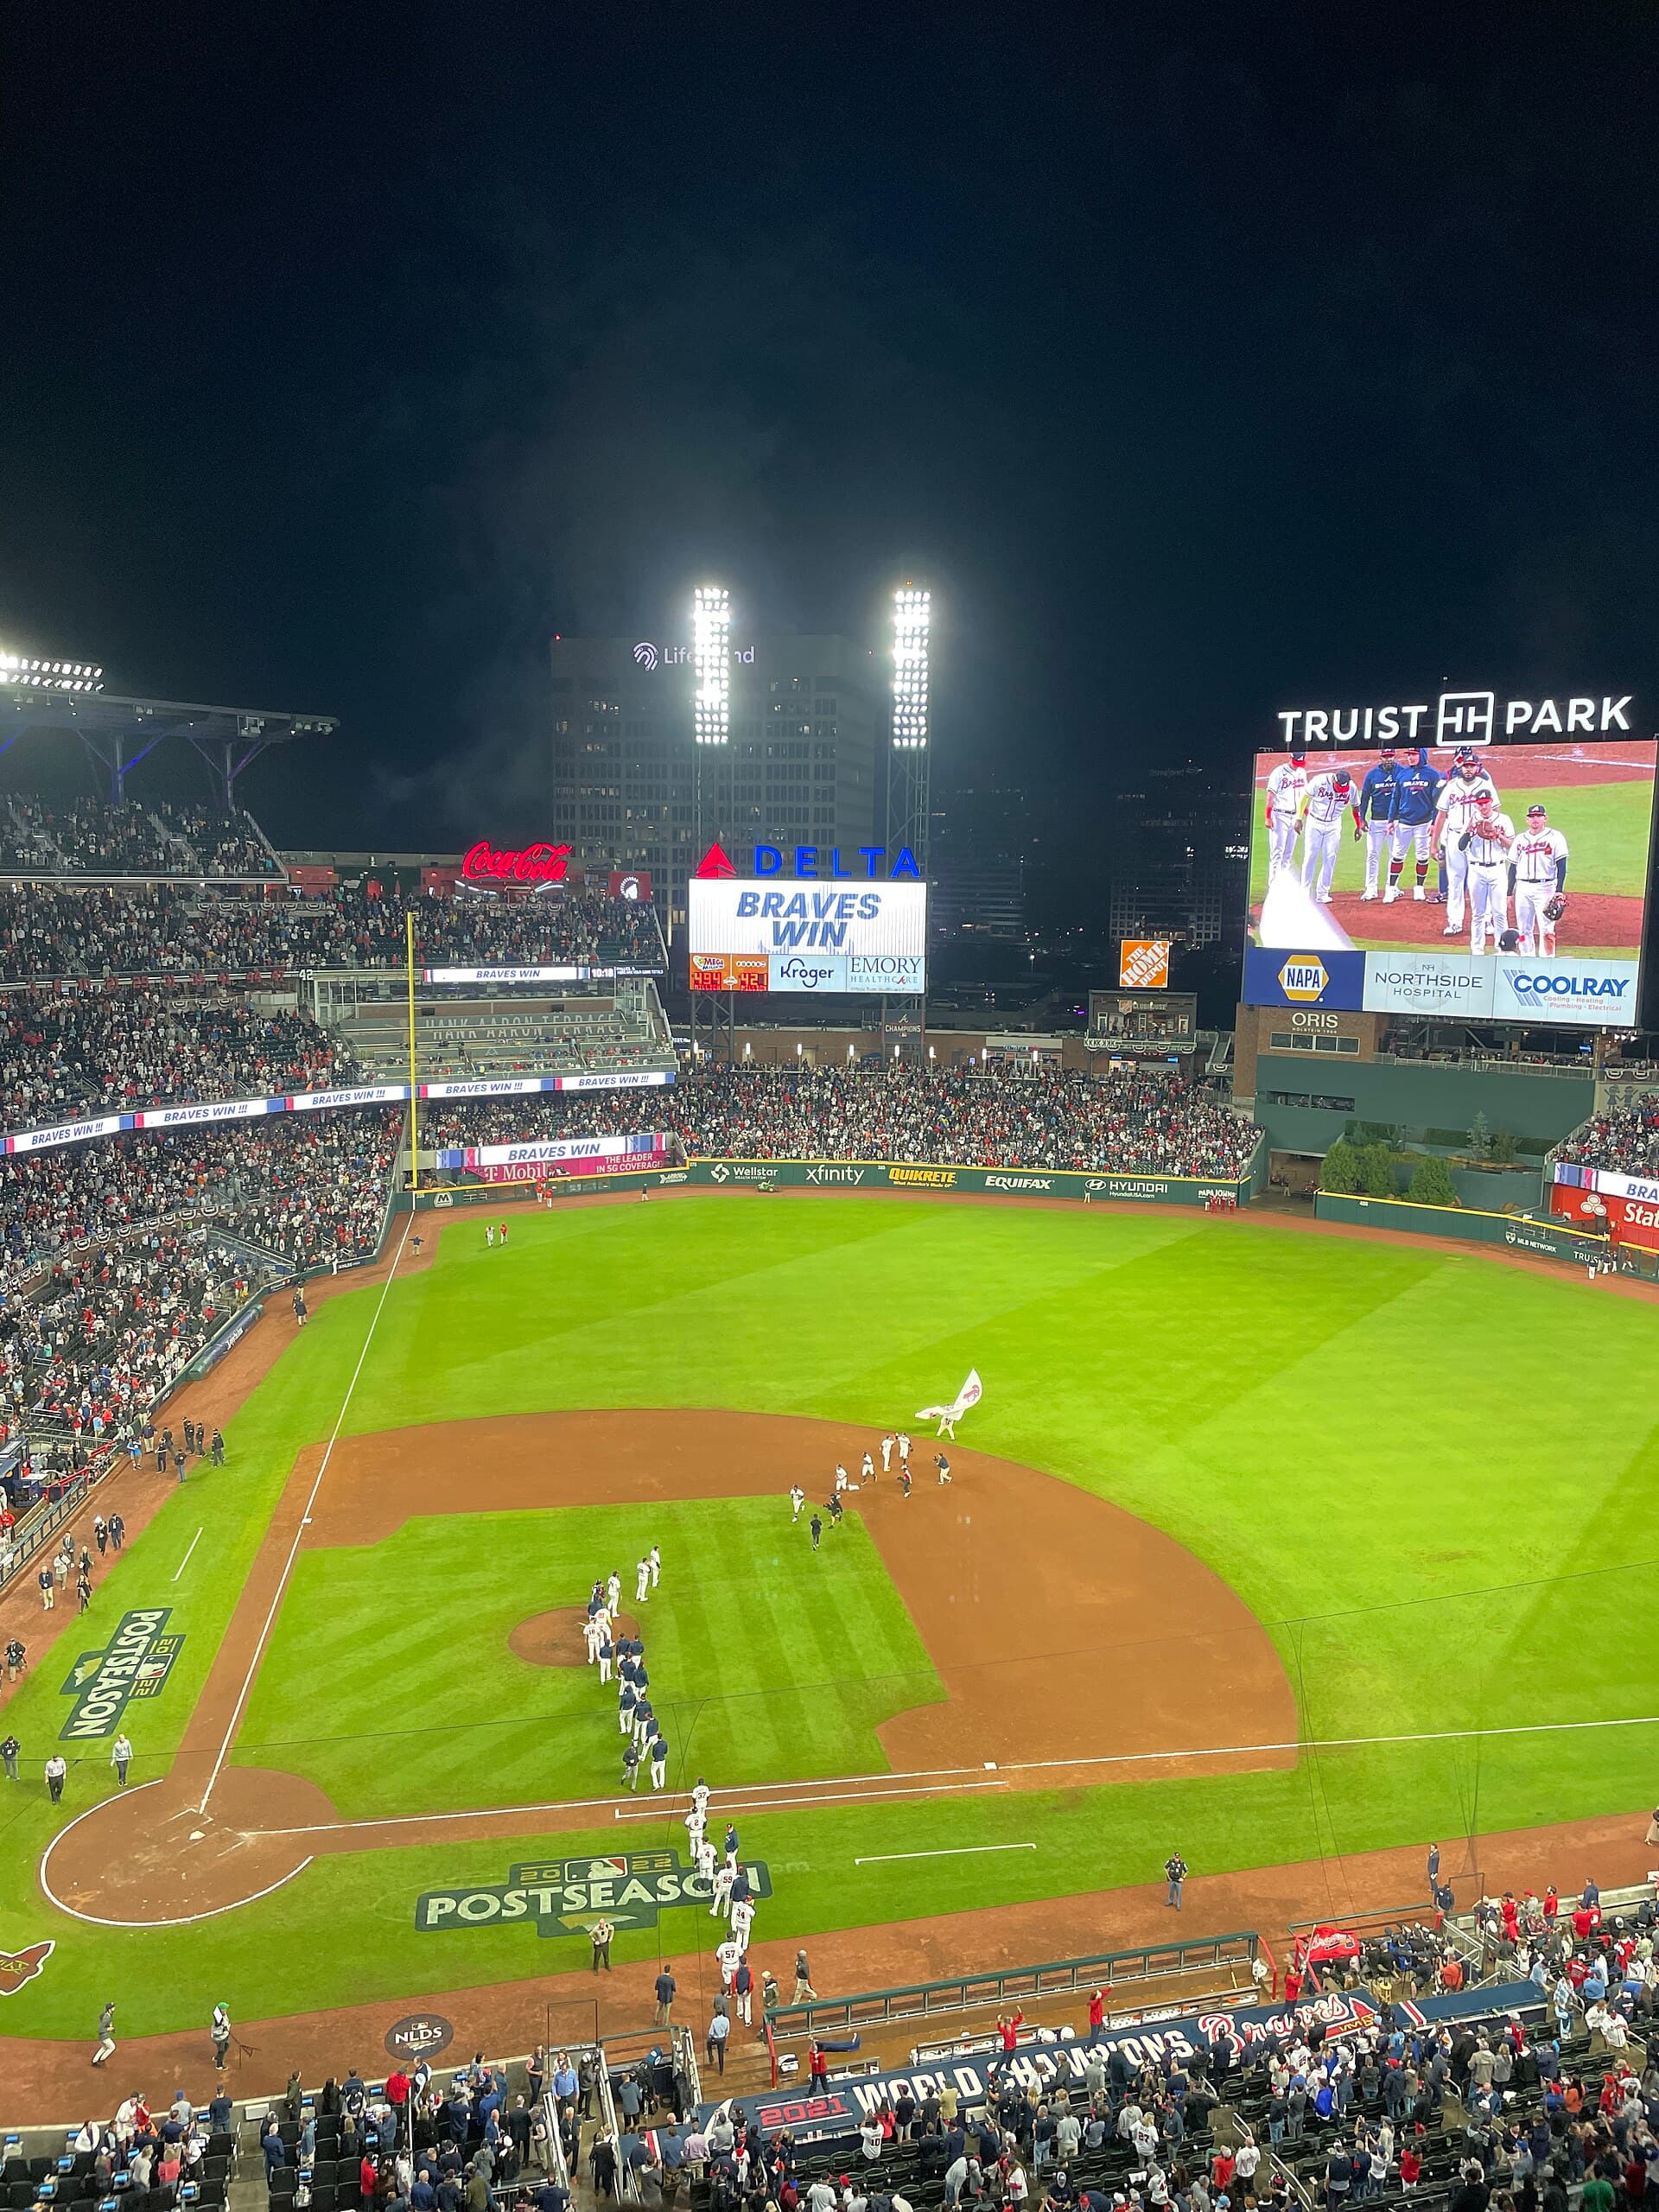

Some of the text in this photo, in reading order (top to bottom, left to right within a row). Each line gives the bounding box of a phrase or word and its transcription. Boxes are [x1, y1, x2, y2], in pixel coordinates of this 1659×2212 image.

[1277, 695, 1633, 743] TRUIST PARK
[461, 840, 574, 880] Coca-Cola
[753, 845, 921, 879] DELTA
[736, 891, 882, 920] BRAVES
[772, 920, 849, 948] WIN
[1121, 940, 1168, 985] HOME
[1126, 945, 1147, 963] THE
[475, 969, 541, 979] BRAVES WIN
[780, 958, 835, 988] Kroger
[850, 957, 922, 975] EMORY
[1138, 957, 1168, 986] DEPOT
[299, 969, 314, 981] 42
[694, 972, 721, 985] 494
[850, 976, 918, 985] HEALTHCARE
[1286, 968, 1321, 988] NAPA
[1375, 971, 1483, 989] NORTHSIDE
[1393, 988, 1462, 1000] HOSPITAL
[1514, 974, 1630, 998] COOLRAY
[885, 1024, 922, 1033] CHAMPIONS
[1292, 1012, 1338, 1028] ORIS
[445, 1084, 489, 1095] BRAVES
[490, 1082, 512, 1092] WIN
[578, 1077, 621, 1088] BRAVES
[621, 1076, 640, 1085] WIN
[312, 1093, 352, 1106] BRAVES
[353, 1090, 374, 1101] WIN
[163, 1108, 210, 1122] BRAVES
[213, 1105, 236, 1116] WIN
[31, 1128, 71, 1146] BRAVES
[73, 1124, 93, 1138] WIN
[508, 1142, 601, 1162] BRAVES WIN
[605, 1152, 653, 1165] THE LEADER
[485, 1162, 550, 1183] T Mobil
[596, 1165, 607, 1174] IN
[607, 1164, 618, 1173] 5G
[733, 1166, 779, 1177] Wellstar
[805, 1164, 865, 1185] xfinity
[888, 1167, 957, 1183] QUIKRETE
[985, 1175, 1052, 1191] EQUIFAX
[1109, 1180, 1168, 1194] HYUNDAI
[1626, 1183, 1658, 1202] BRA
[1623, 1202, 1659, 1229] Stat
[1516, 1236, 1557, 1253] MLB NETWORK
[1573, 1250, 1599, 1263] TRUIS
[67, 1611, 164, 1737] POSTSEASON
[697, 1791, 707, 1800] 37
[520, 1857, 672, 1883] 20 22
[722, 1875, 733, 1884] 59
[736, 1908, 746, 1919] 34
[725, 1949, 735, 1959] 57
[395, 2026, 443, 2044] NLDS
[760, 2097, 849, 2127] 2021
[1198, 1993, 1350, 2058] Braves
